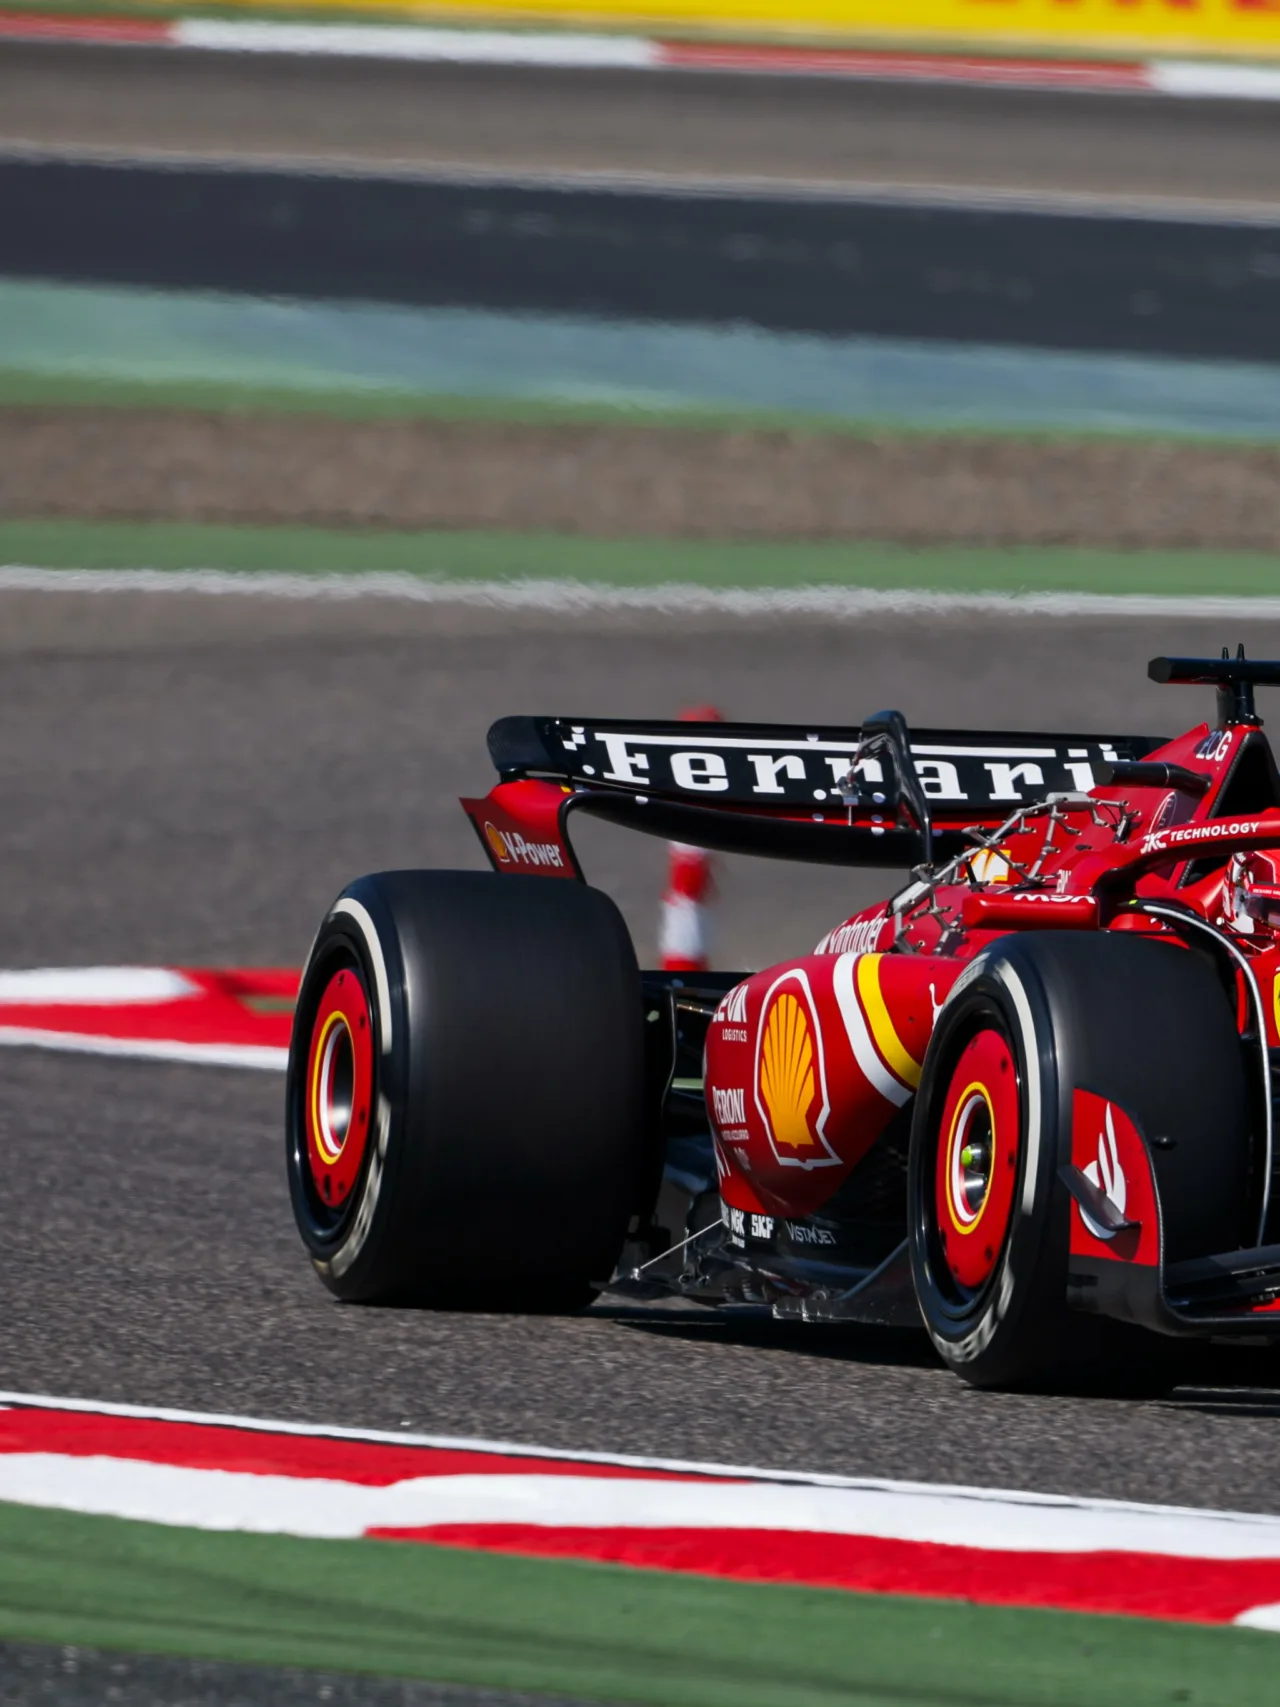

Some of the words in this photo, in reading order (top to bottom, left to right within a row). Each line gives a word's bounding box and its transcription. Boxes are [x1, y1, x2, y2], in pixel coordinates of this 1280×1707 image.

[594, 732, 1098, 800] Ferrari
[499, 831, 564, 867] V-Power
[1170, 822, 1259, 841] TECHNOLOGY
[712, 1086, 746, 1124] PERONI
[751, 1214, 774, 1239] SKF
